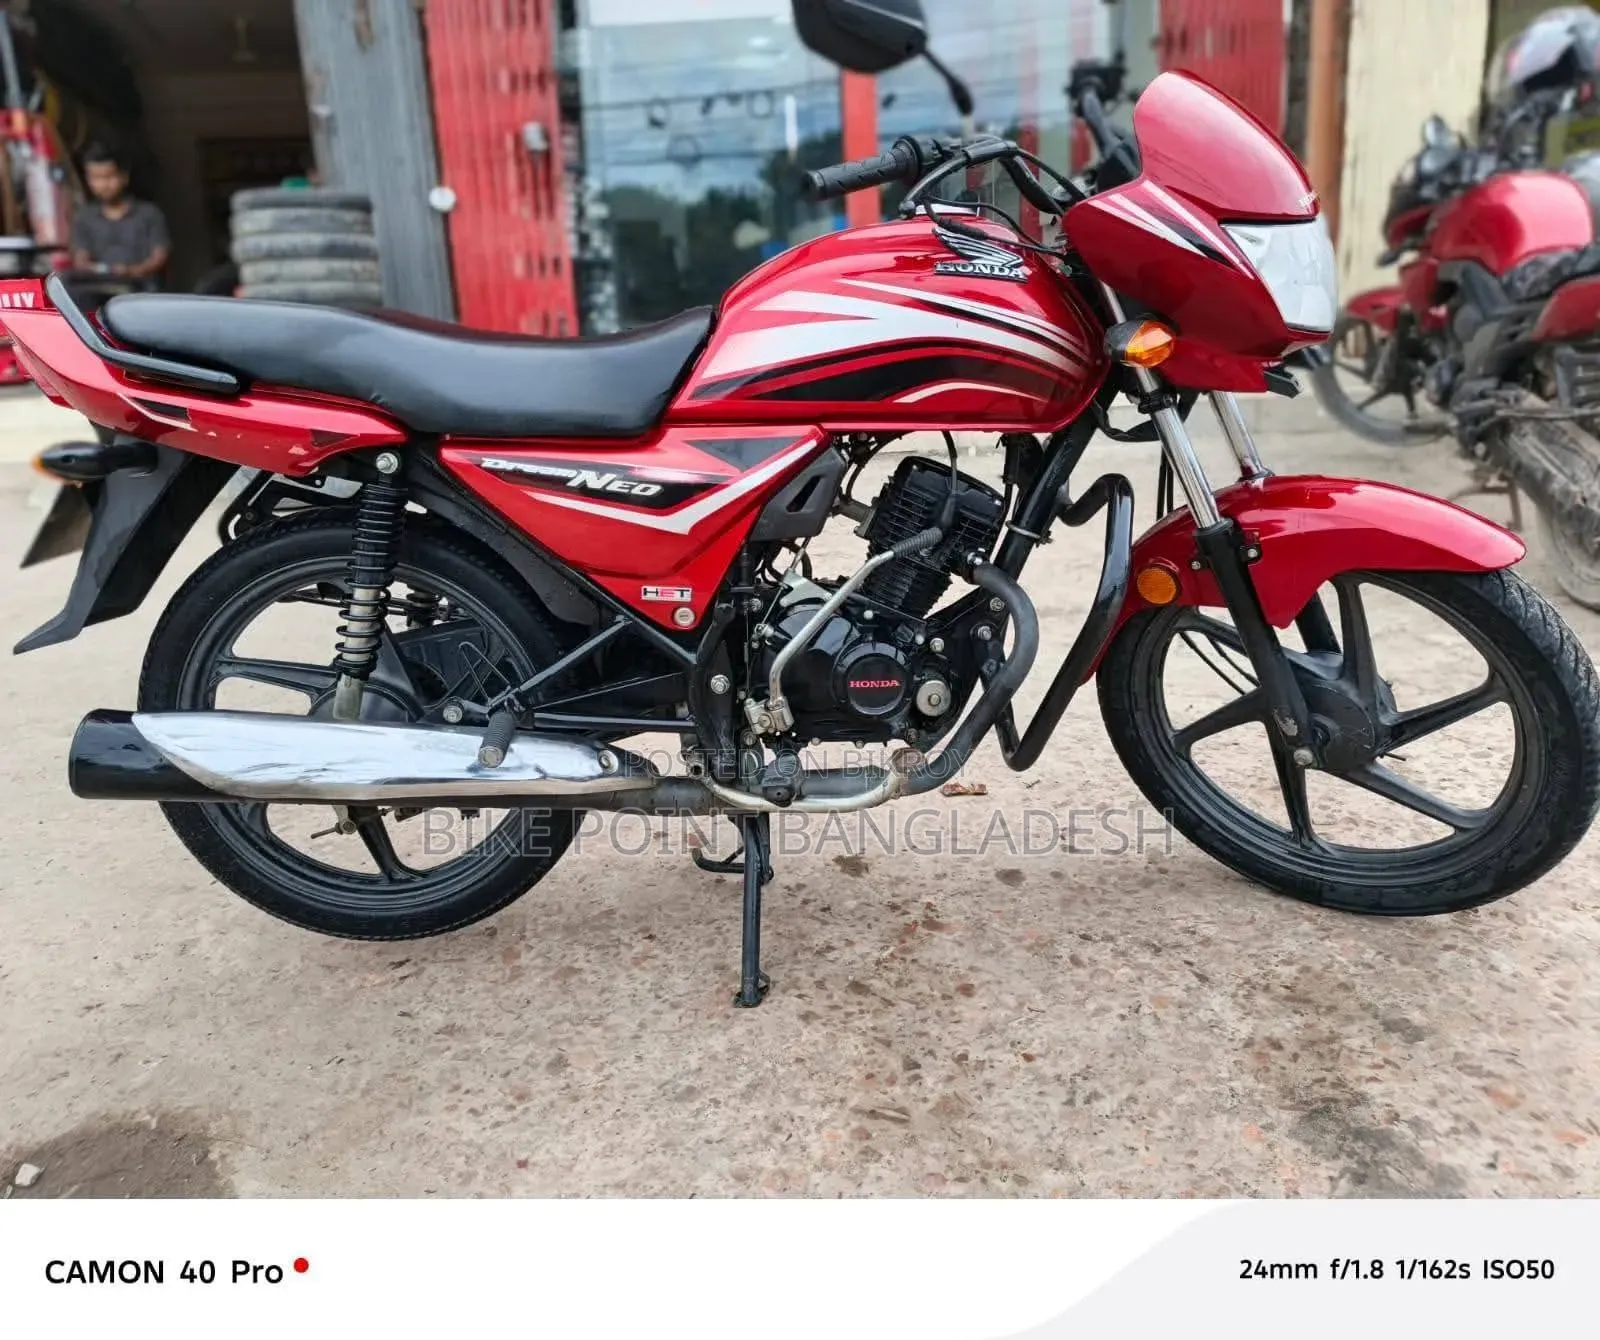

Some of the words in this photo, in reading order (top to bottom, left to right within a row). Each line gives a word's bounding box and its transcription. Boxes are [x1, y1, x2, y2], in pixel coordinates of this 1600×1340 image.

[934, 262, 1027, 279] HONDA
[643, 587, 690, 598] HET
[849, 679, 901, 688] HONDA
